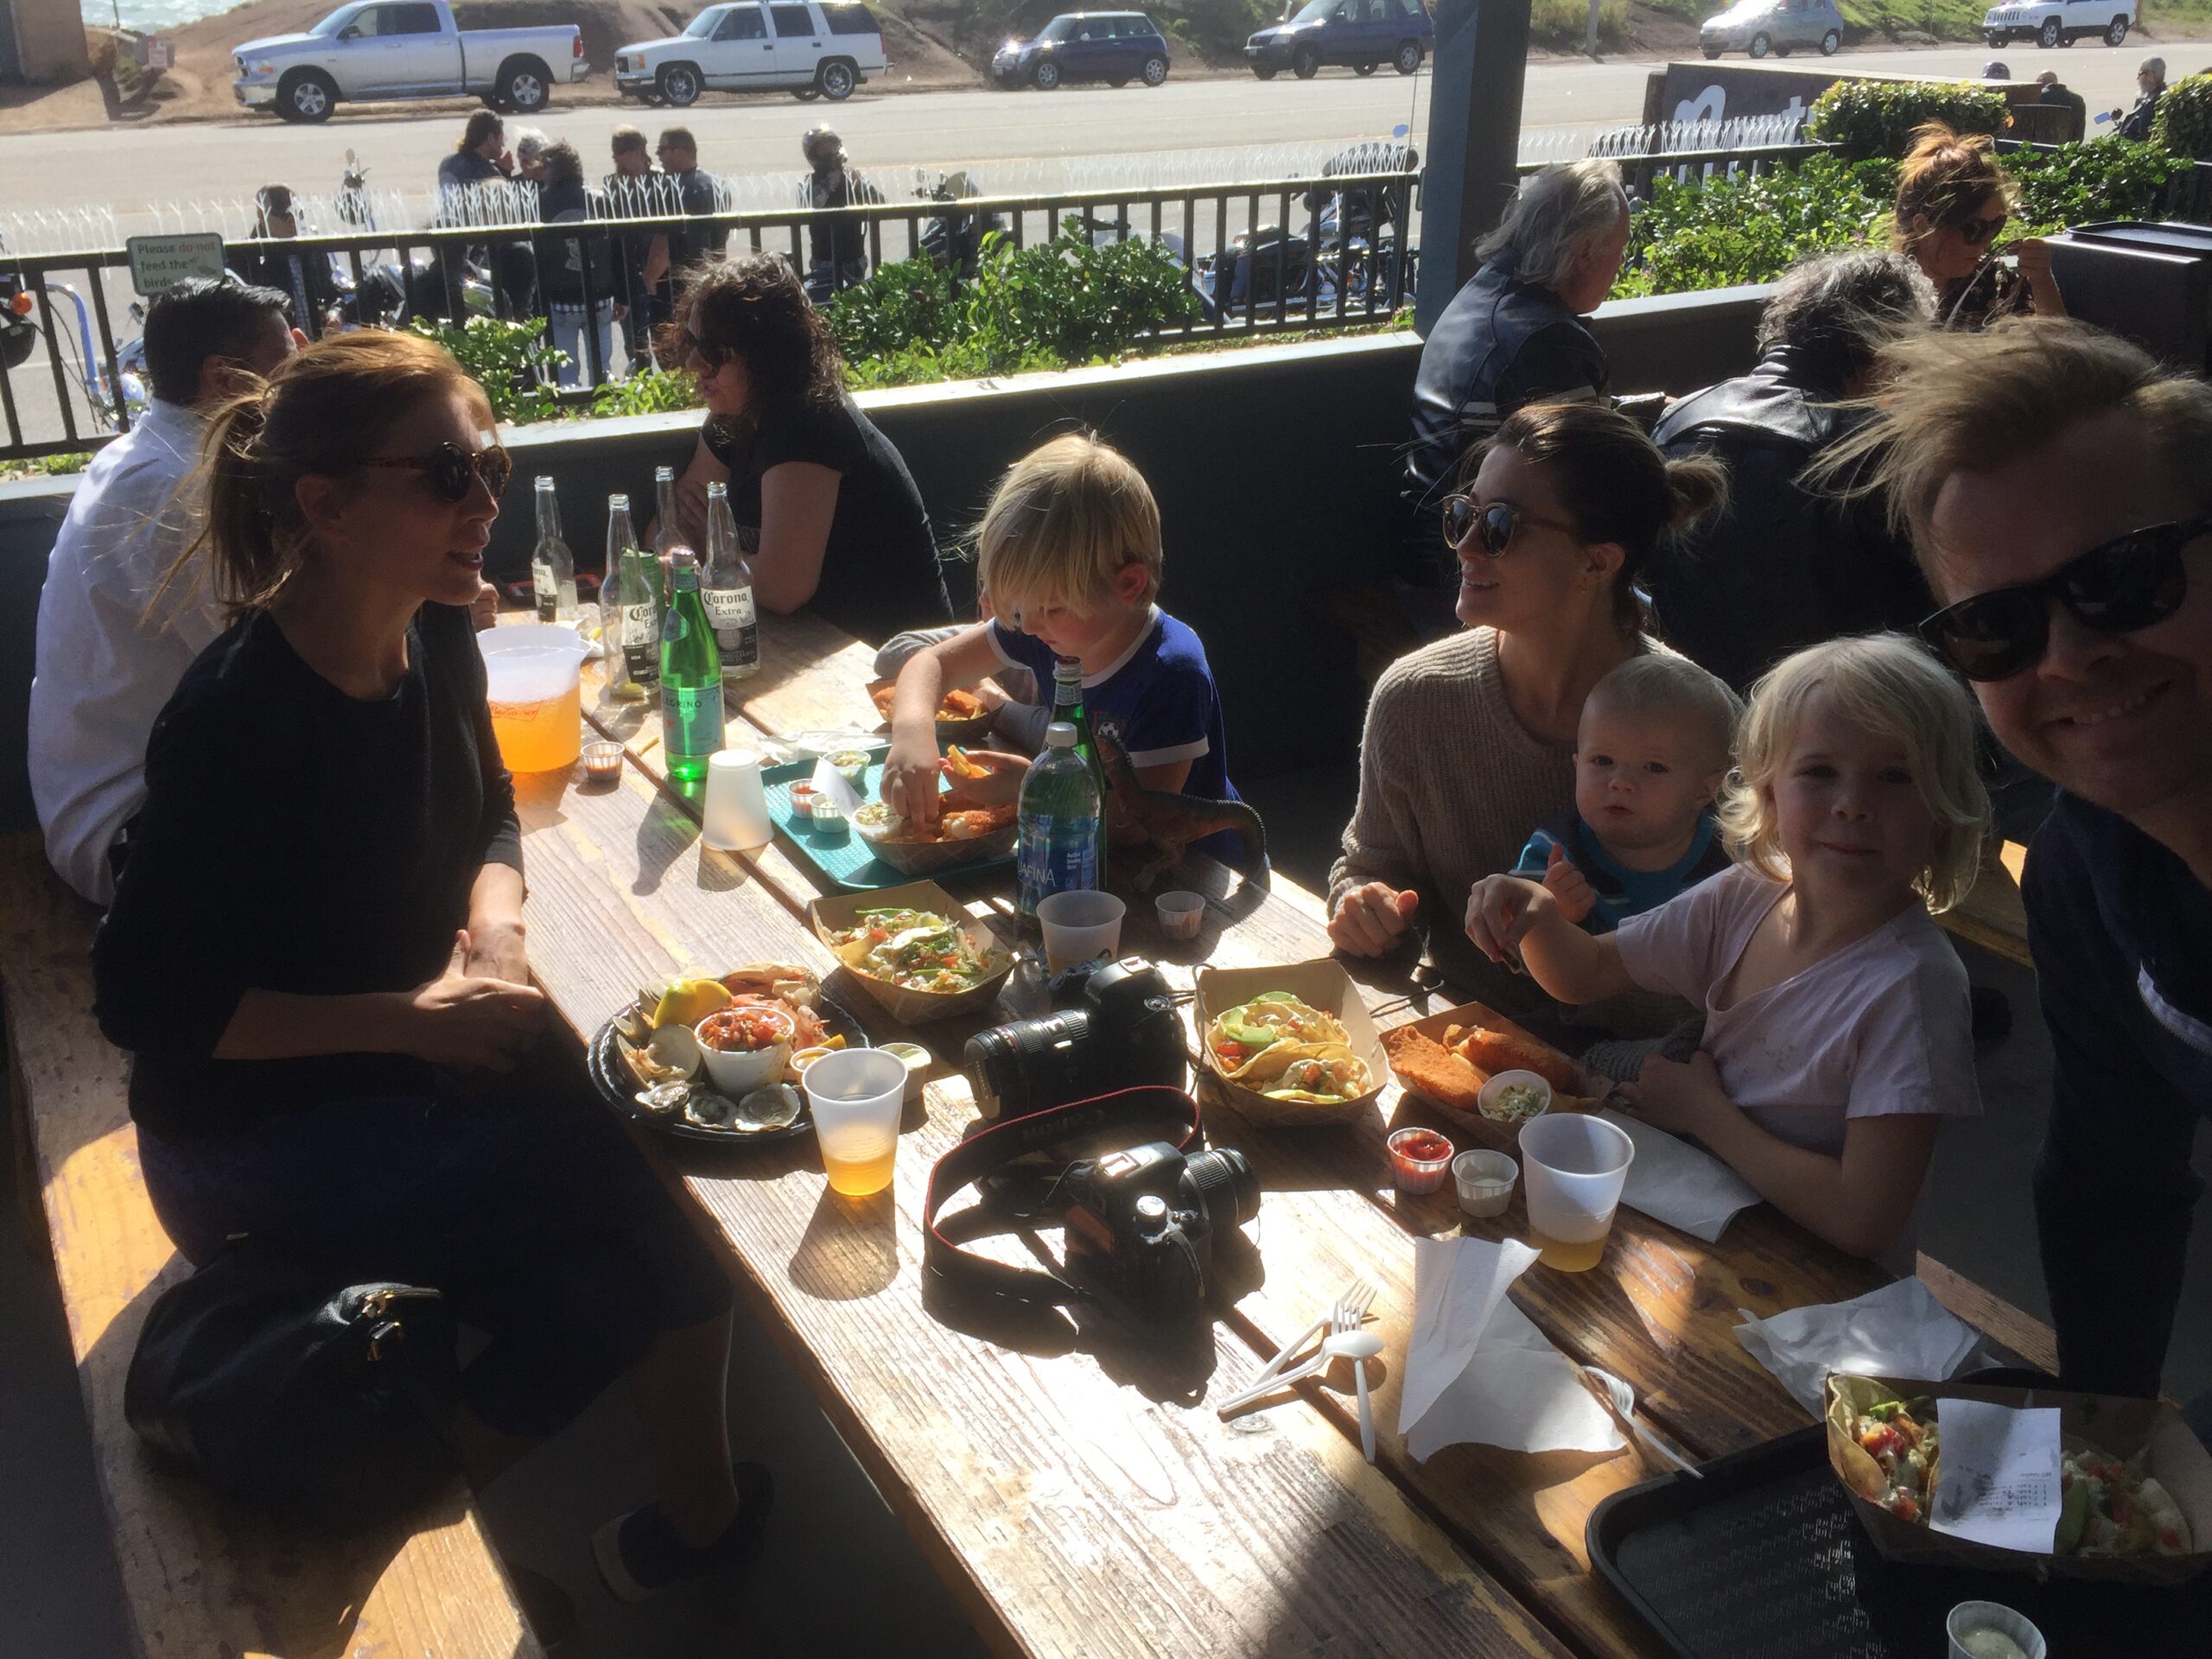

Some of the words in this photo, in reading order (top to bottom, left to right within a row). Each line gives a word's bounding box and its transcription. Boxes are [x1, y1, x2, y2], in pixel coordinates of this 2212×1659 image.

[138, 244, 175, 254] Please
[179, 243, 193, 252] do
[197, 242, 215, 251] not
[141, 261, 166, 273] feed
[169, 259, 188, 270] the
[143, 277, 173, 289] birds
[703, 591, 747, 607] Corona
[715, 606, 741, 616] Extra
